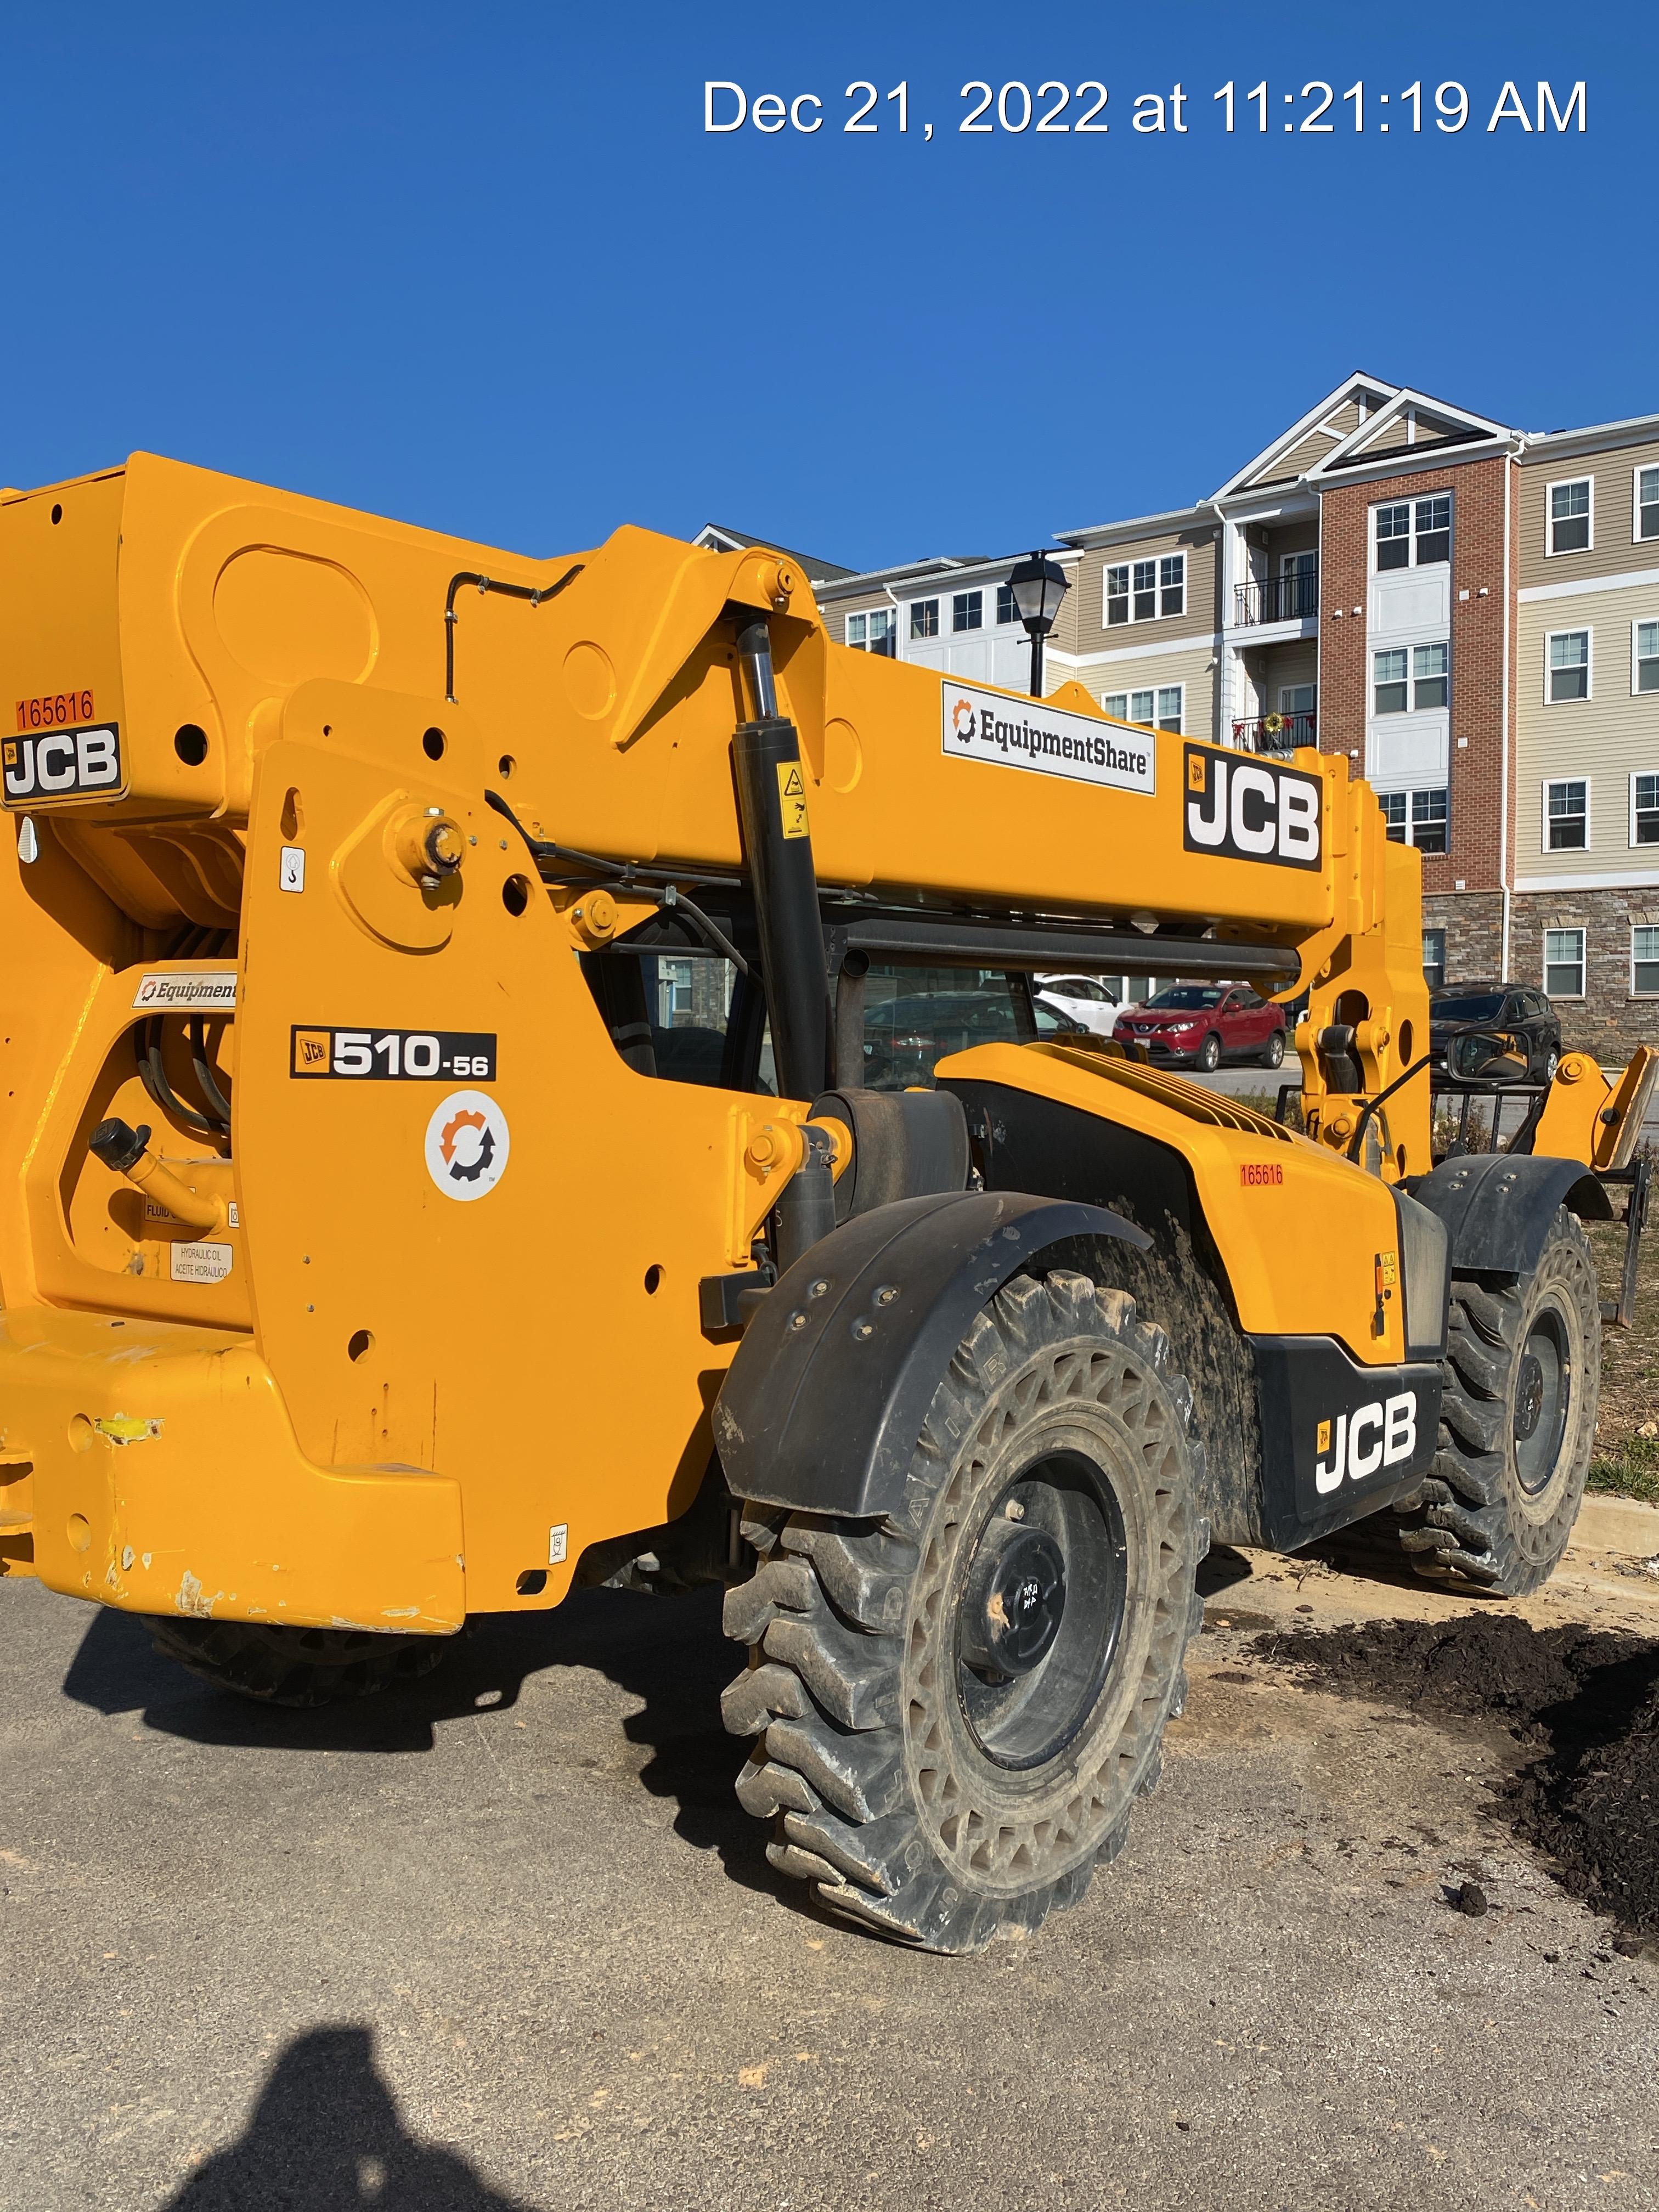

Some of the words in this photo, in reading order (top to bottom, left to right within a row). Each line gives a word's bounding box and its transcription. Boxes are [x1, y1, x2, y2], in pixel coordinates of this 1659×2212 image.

[18, 690, 93, 729] 165616
[980, 709, 1147, 775] EquipmentShare
[5, 730, 118, 794] JCB
[1188, 760, 1319, 861] JCB
[304, 1042, 324, 1062] JCB
[1242, 1165, 1283, 1185] 165616
[175, 1263, 193, 1275] ACEITE
[181, 1248, 211, 1260] HYDRAULIC
[212, 1250, 222, 1261] OIL
[1316, 1391, 1417, 1494] JCB
